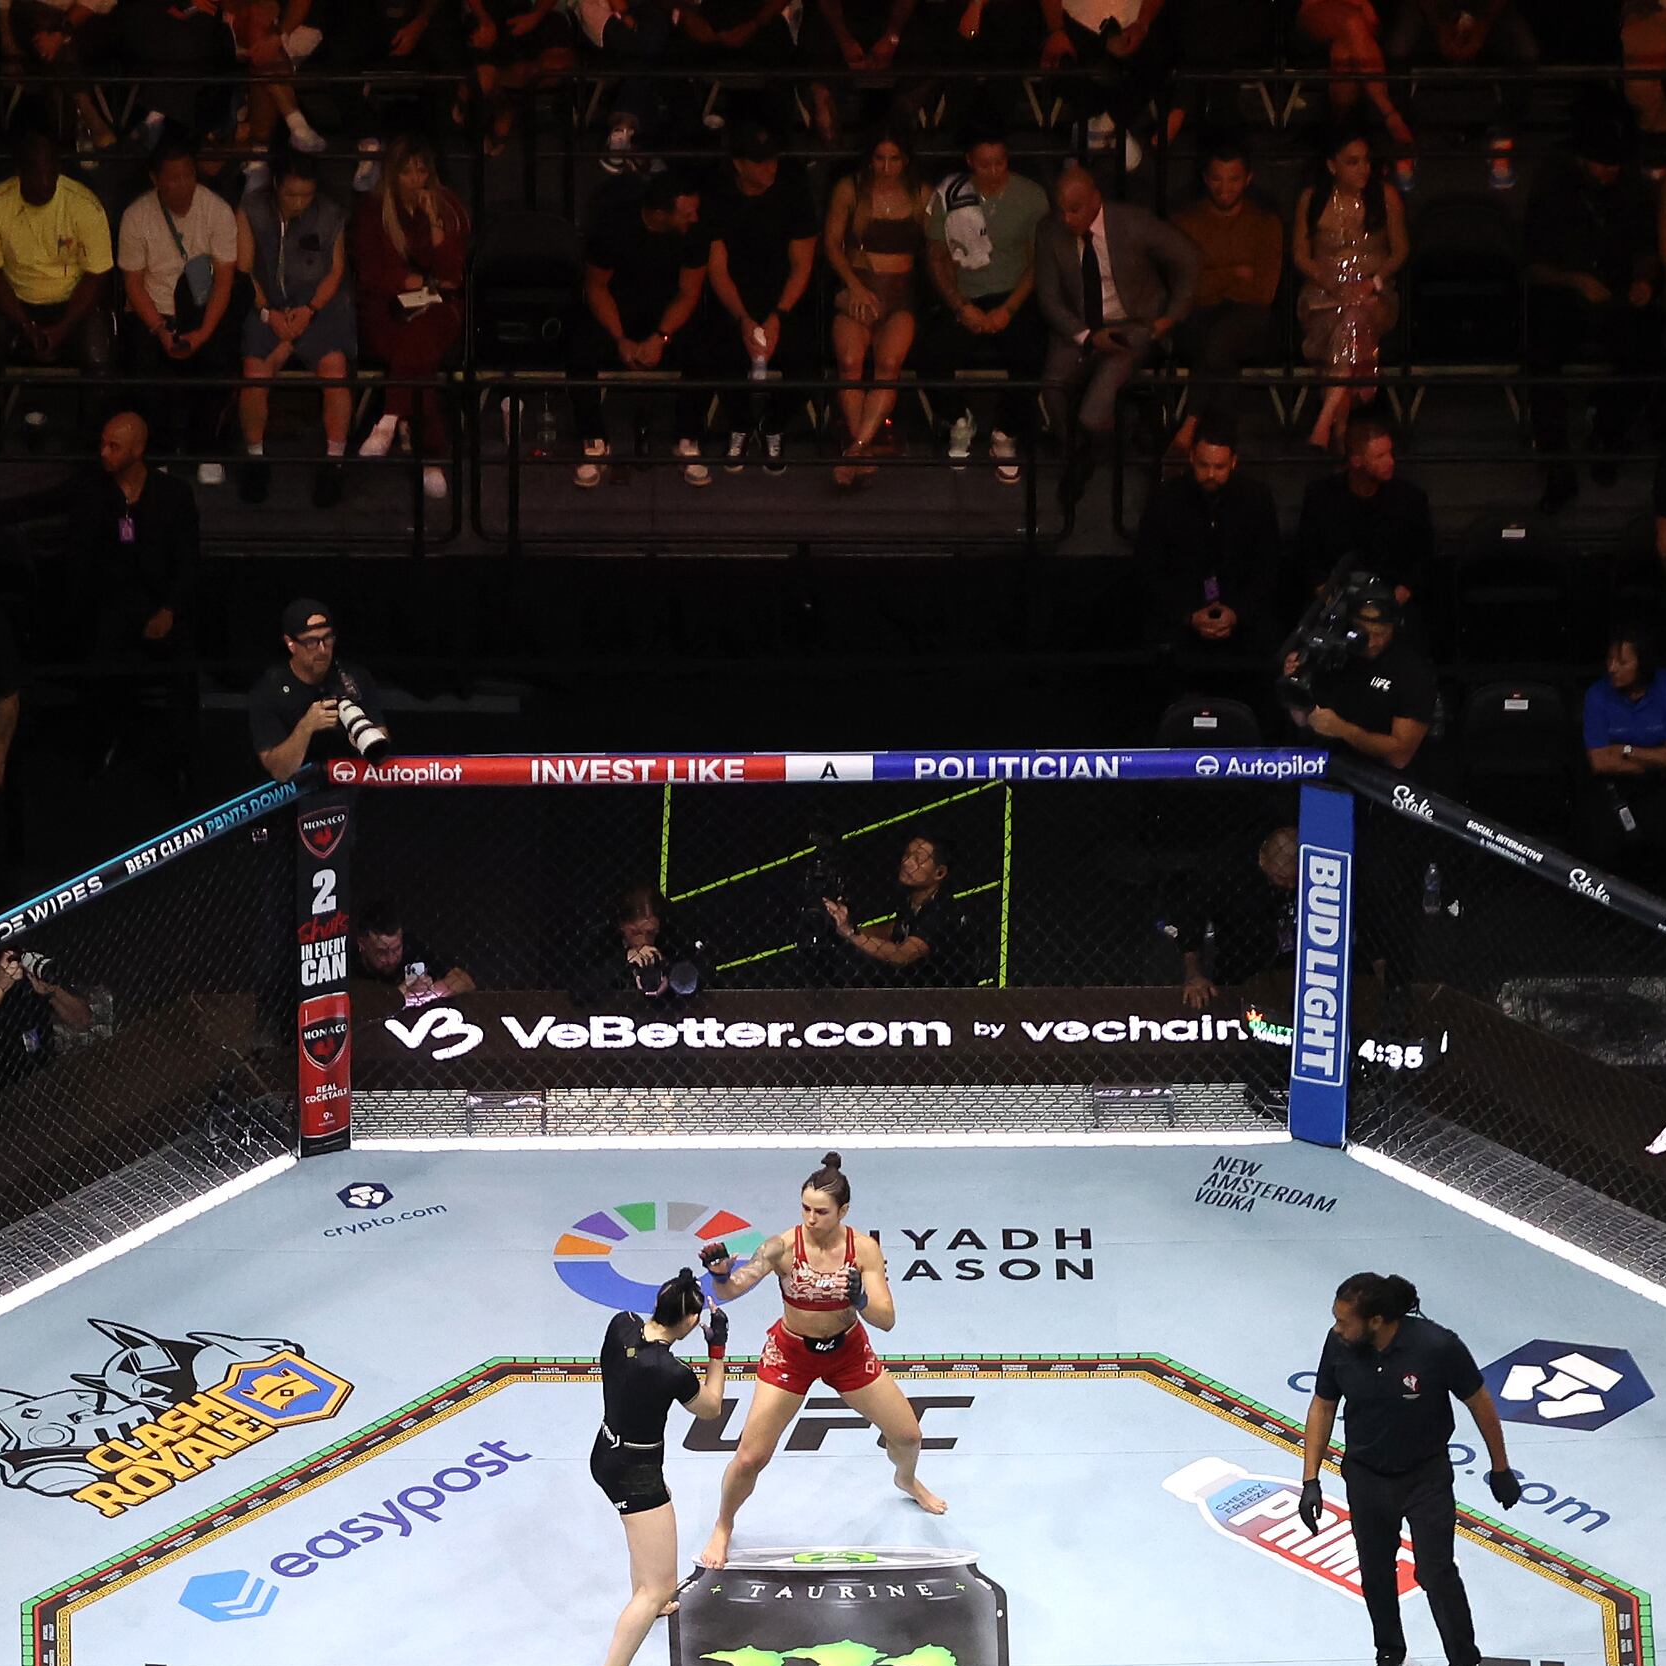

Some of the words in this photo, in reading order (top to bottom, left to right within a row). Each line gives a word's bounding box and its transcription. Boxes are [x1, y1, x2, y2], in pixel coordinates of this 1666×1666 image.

[362, 761, 463, 785] Autopilot
[530, 758, 656, 784] INVEST
[666, 758, 746, 783] LIKE
[821, 761, 839, 780] A
[1225, 755, 1326, 779] Autopilot
[1391, 784, 1434, 822] Stake
[124, 850, 158, 876] BEST
[160, 825, 206, 858] CLEAN
[205, 803, 249, 837] PANTS
[250, 782, 297, 814] DOWN
[303, 813, 346, 832] MONACO
[27, 875, 104, 924] WIPES
[311, 869, 337, 916] 2
[1307, 853, 1343, 946] BUD
[1568, 868, 1611, 905] Stake
[301, 943, 313, 962] IN
[314, 935, 348, 960] EVERY
[300, 952, 348, 987] CAN
[1302, 950, 1340, 1077] LIGHT
[303, 1022, 349, 1043] MONACO
[502, 1015, 953, 1050] VeBetter.com
[973, 1020, 1007, 1040] by
[1357, 1038, 1424, 1070] 4:35
[304, 1087, 349, 1105] COCKTAILS
[315, 1082, 338, 1096] REAL
[1213, 1155, 1263, 1177] NEW
[1194, 1188, 1256, 1213] VODKA
[1203, 1173, 1338, 1214] AMSTERDAM
[322, 1202, 448, 1240] crypto.com
[869, 1228, 1093, 1250] IYADH
[85, 1392, 236, 1473] CLASH
[73, 1411, 279, 1519] ROYALE
[270, 1440, 533, 1578] easypost
[1215, 1482, 1265, 1511] CHERRY
[1225, 1488, 1271, 1516] FREEZE
[750, 1582, 934, 1599] TAURINE
